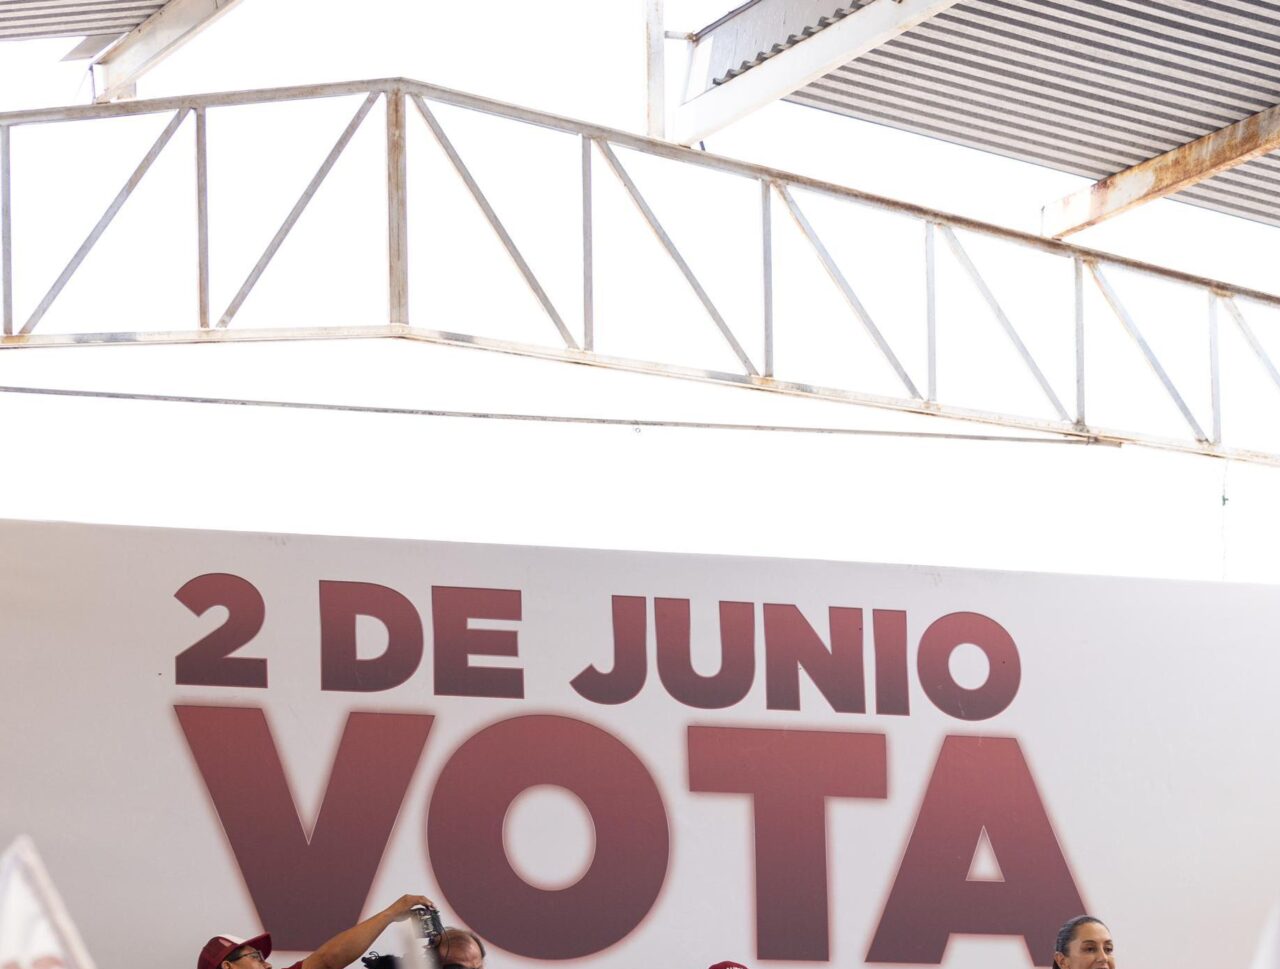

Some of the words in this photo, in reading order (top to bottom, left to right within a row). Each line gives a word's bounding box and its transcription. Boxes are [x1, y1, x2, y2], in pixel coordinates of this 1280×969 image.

[173, 572, 268, 689] 2
[318, 579, 525, 699] DE
[568, 594, 1022, 722] JUNIO
[172, 704, 1092, 968] VOTA
